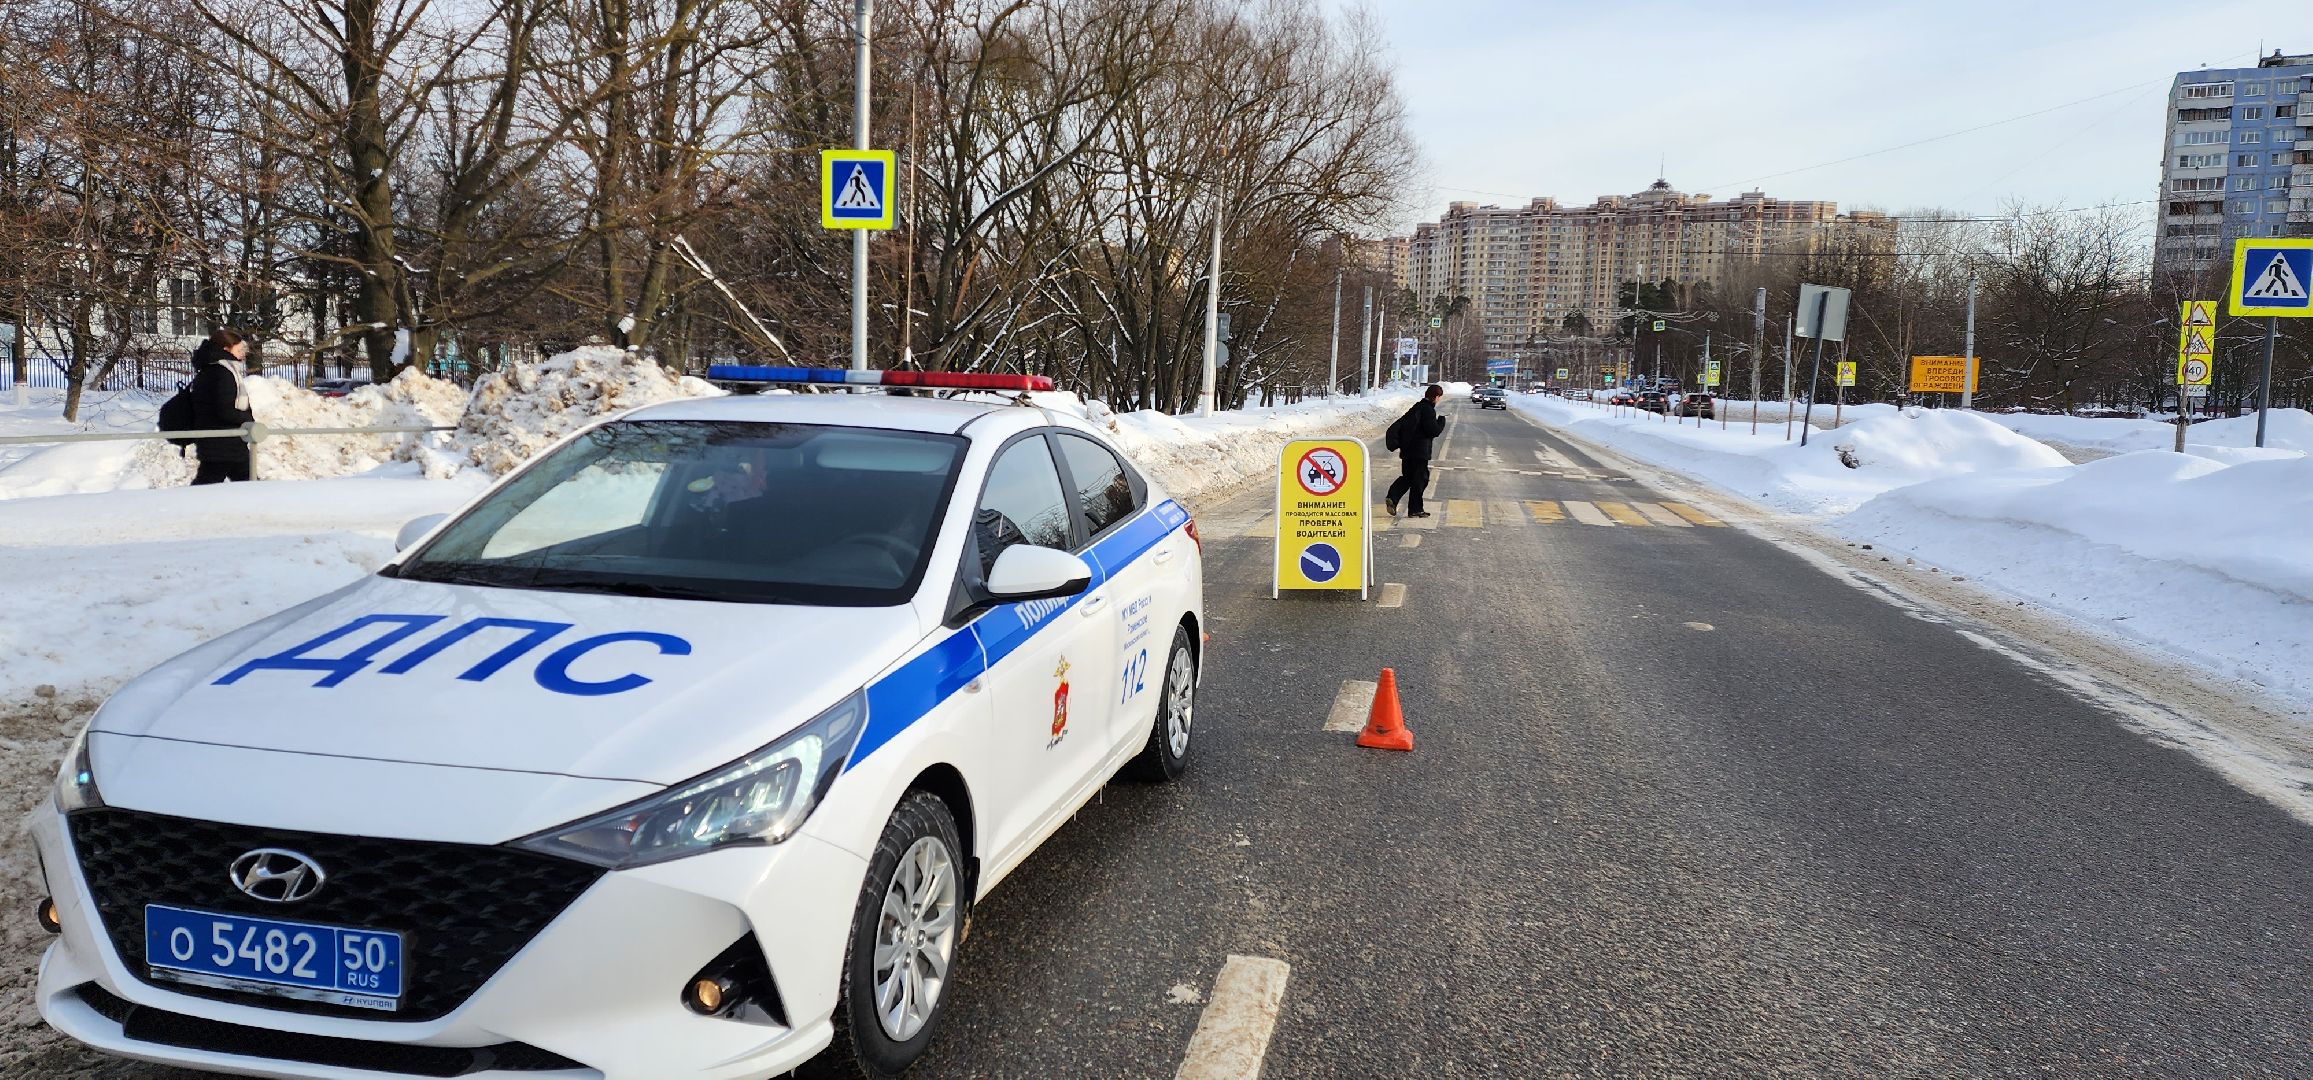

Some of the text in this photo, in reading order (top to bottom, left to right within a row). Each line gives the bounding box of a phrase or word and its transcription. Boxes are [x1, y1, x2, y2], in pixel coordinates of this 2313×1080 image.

[1927, 367, 1964, 375] ВПЕРЕДИ
[2188, 366, 2202, 375] 40
[1913, 382, 1976, 390] ОГРАЖДЕНИ!
[1297, 501, 1346, 509] ВНИМАНИЕ!
[1299, 519, 1343, 527] ПРОВЕРКА
[1296, 529, 1346, 538] ВОДИТЕЛЕЙ!
[1014, 595, 1076, 631] ПОЛИЦ
[211, 613, 692, 697] ДПС
[1121, 648, 1147, 705] 112
[211, 921, 318, 980] 5482
[343, 934, 386, 973] 50
[347, 972, 380, 989] RUS
[356, 998, 393, 1009] HYUNDAI
